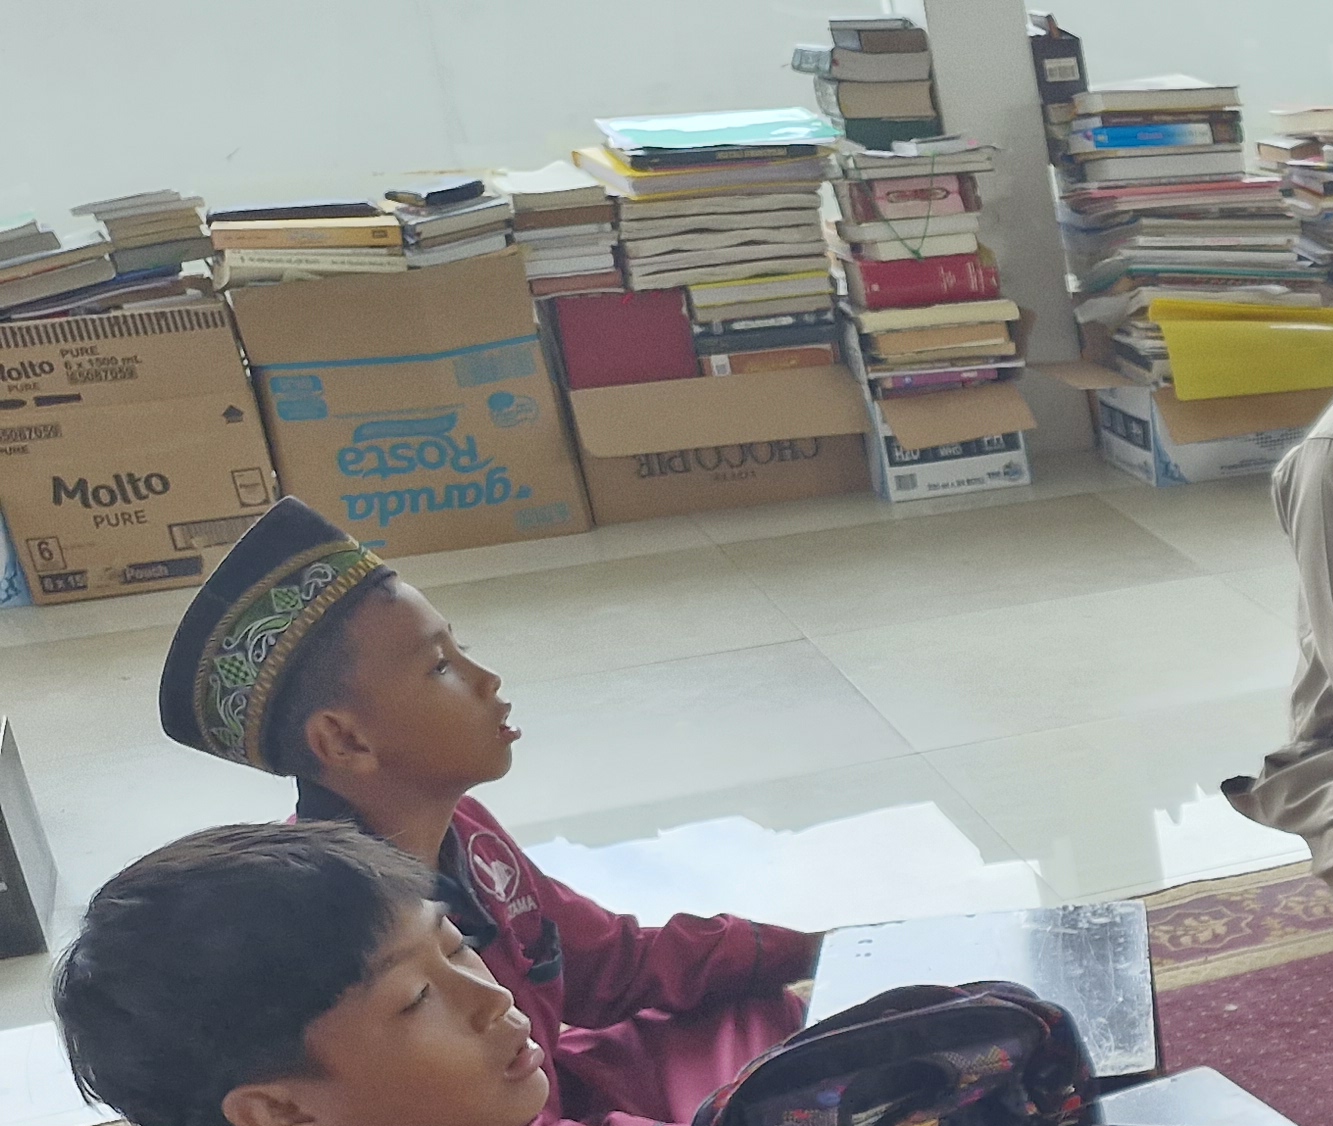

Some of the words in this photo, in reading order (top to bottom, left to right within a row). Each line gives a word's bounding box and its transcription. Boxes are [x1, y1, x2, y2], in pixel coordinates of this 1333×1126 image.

[336, 435, 494, 479] Rosta
[52, 472, 171, 509] Molto
[341, 466, 511, 528] garuda
[93, 510, 148, 529] PURE
[37, 540, 54, 562] 6
